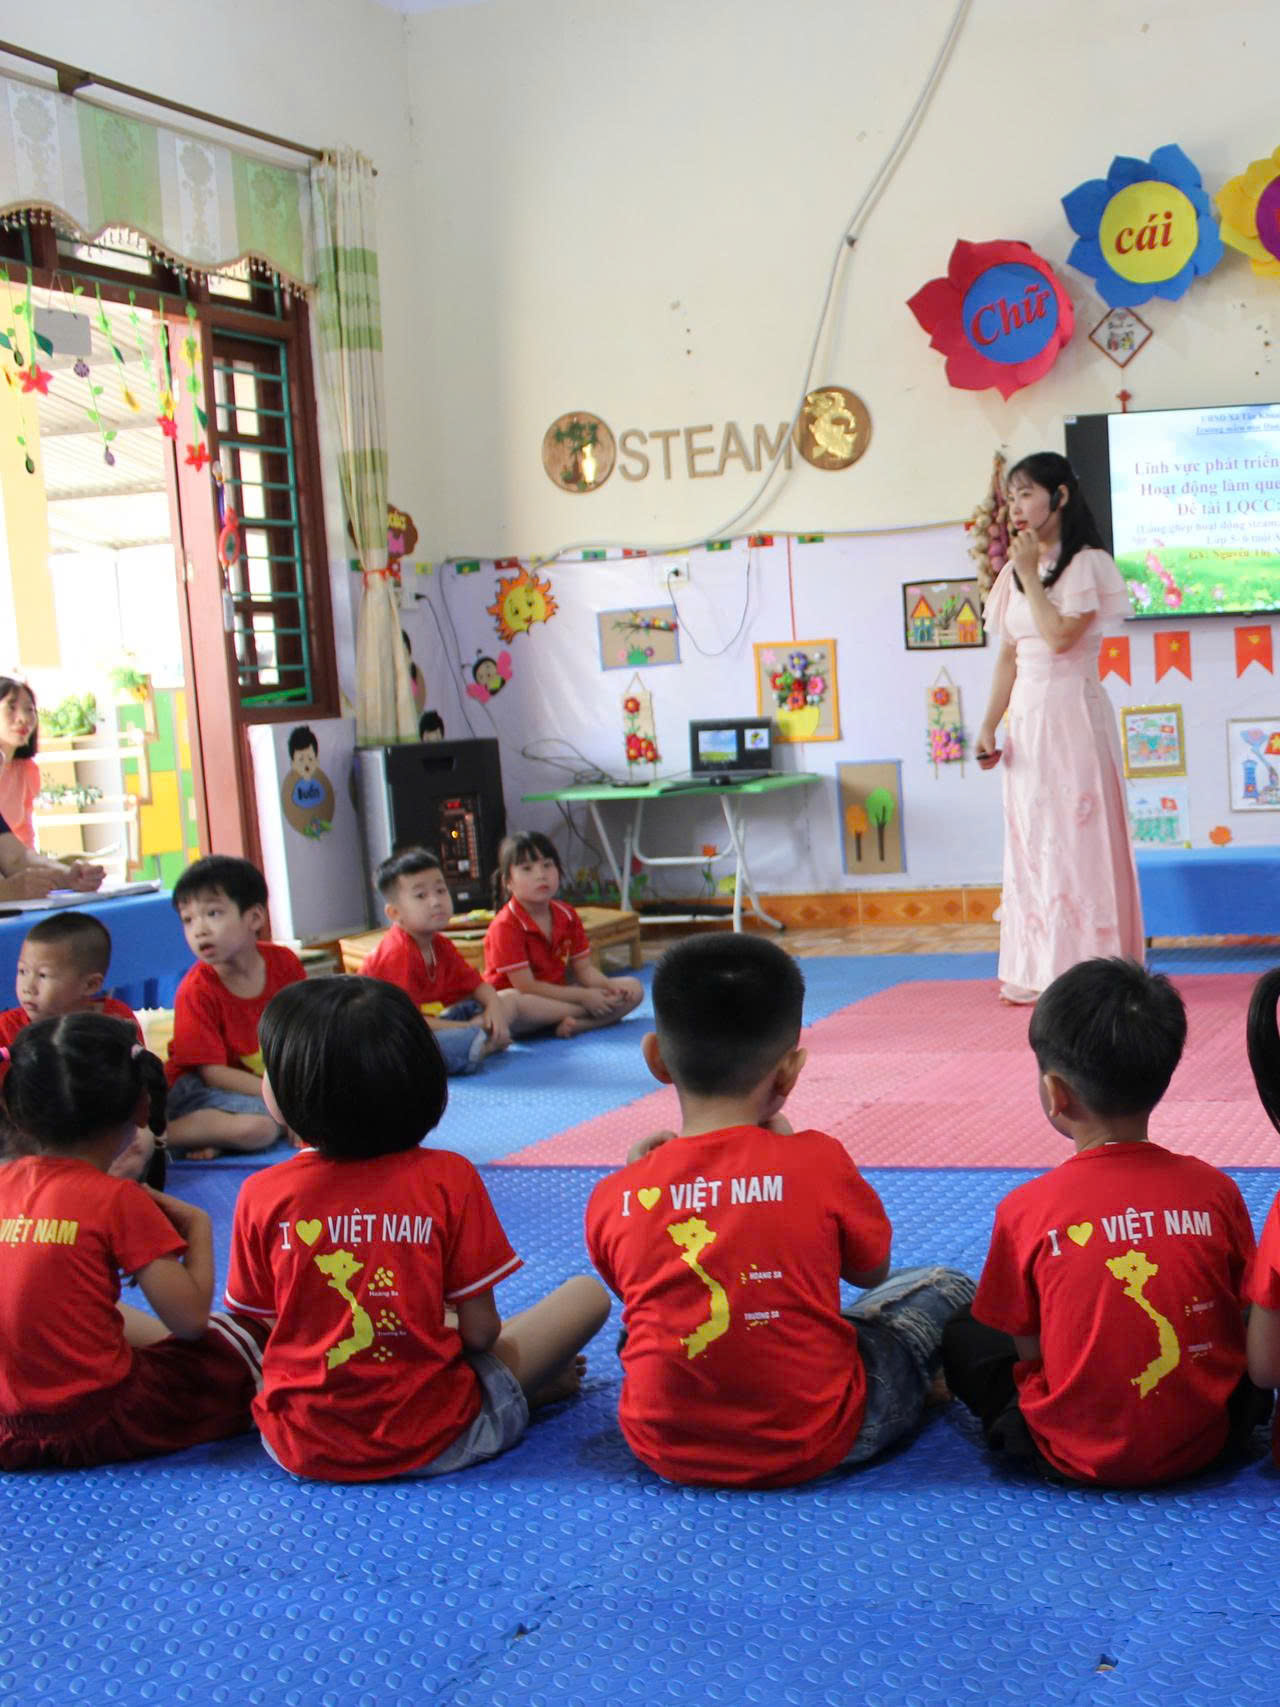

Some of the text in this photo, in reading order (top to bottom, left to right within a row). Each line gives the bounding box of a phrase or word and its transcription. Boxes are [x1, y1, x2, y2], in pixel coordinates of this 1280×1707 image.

[971, 283, 1050, 346] Chữ
[1114, 211, 1174, 254] cái
[618, 421, 794, 482] STEAM
[1135, 460, 1169, 475] Lĩnh
[1174, 461, 1201, 476] vực
[1205, 457, 1239, 475] phát
[1244, 452, 1280, 469] triển
[1140, 482, 1177, 499] Hoạt
[1181, 480, 1218, 497] động
[1223, 478, 1251, 492] làm
[1202, 500, 1221, 514] tài
[622, 1175, 783, 1217] I VIỆT NAM
[33, 1218, 79, 1246] NAM
[278, 1207, 433, 1251] I VIỆT NAM
[1047, 1207, 1213, 1257] I VIỆT NAM
